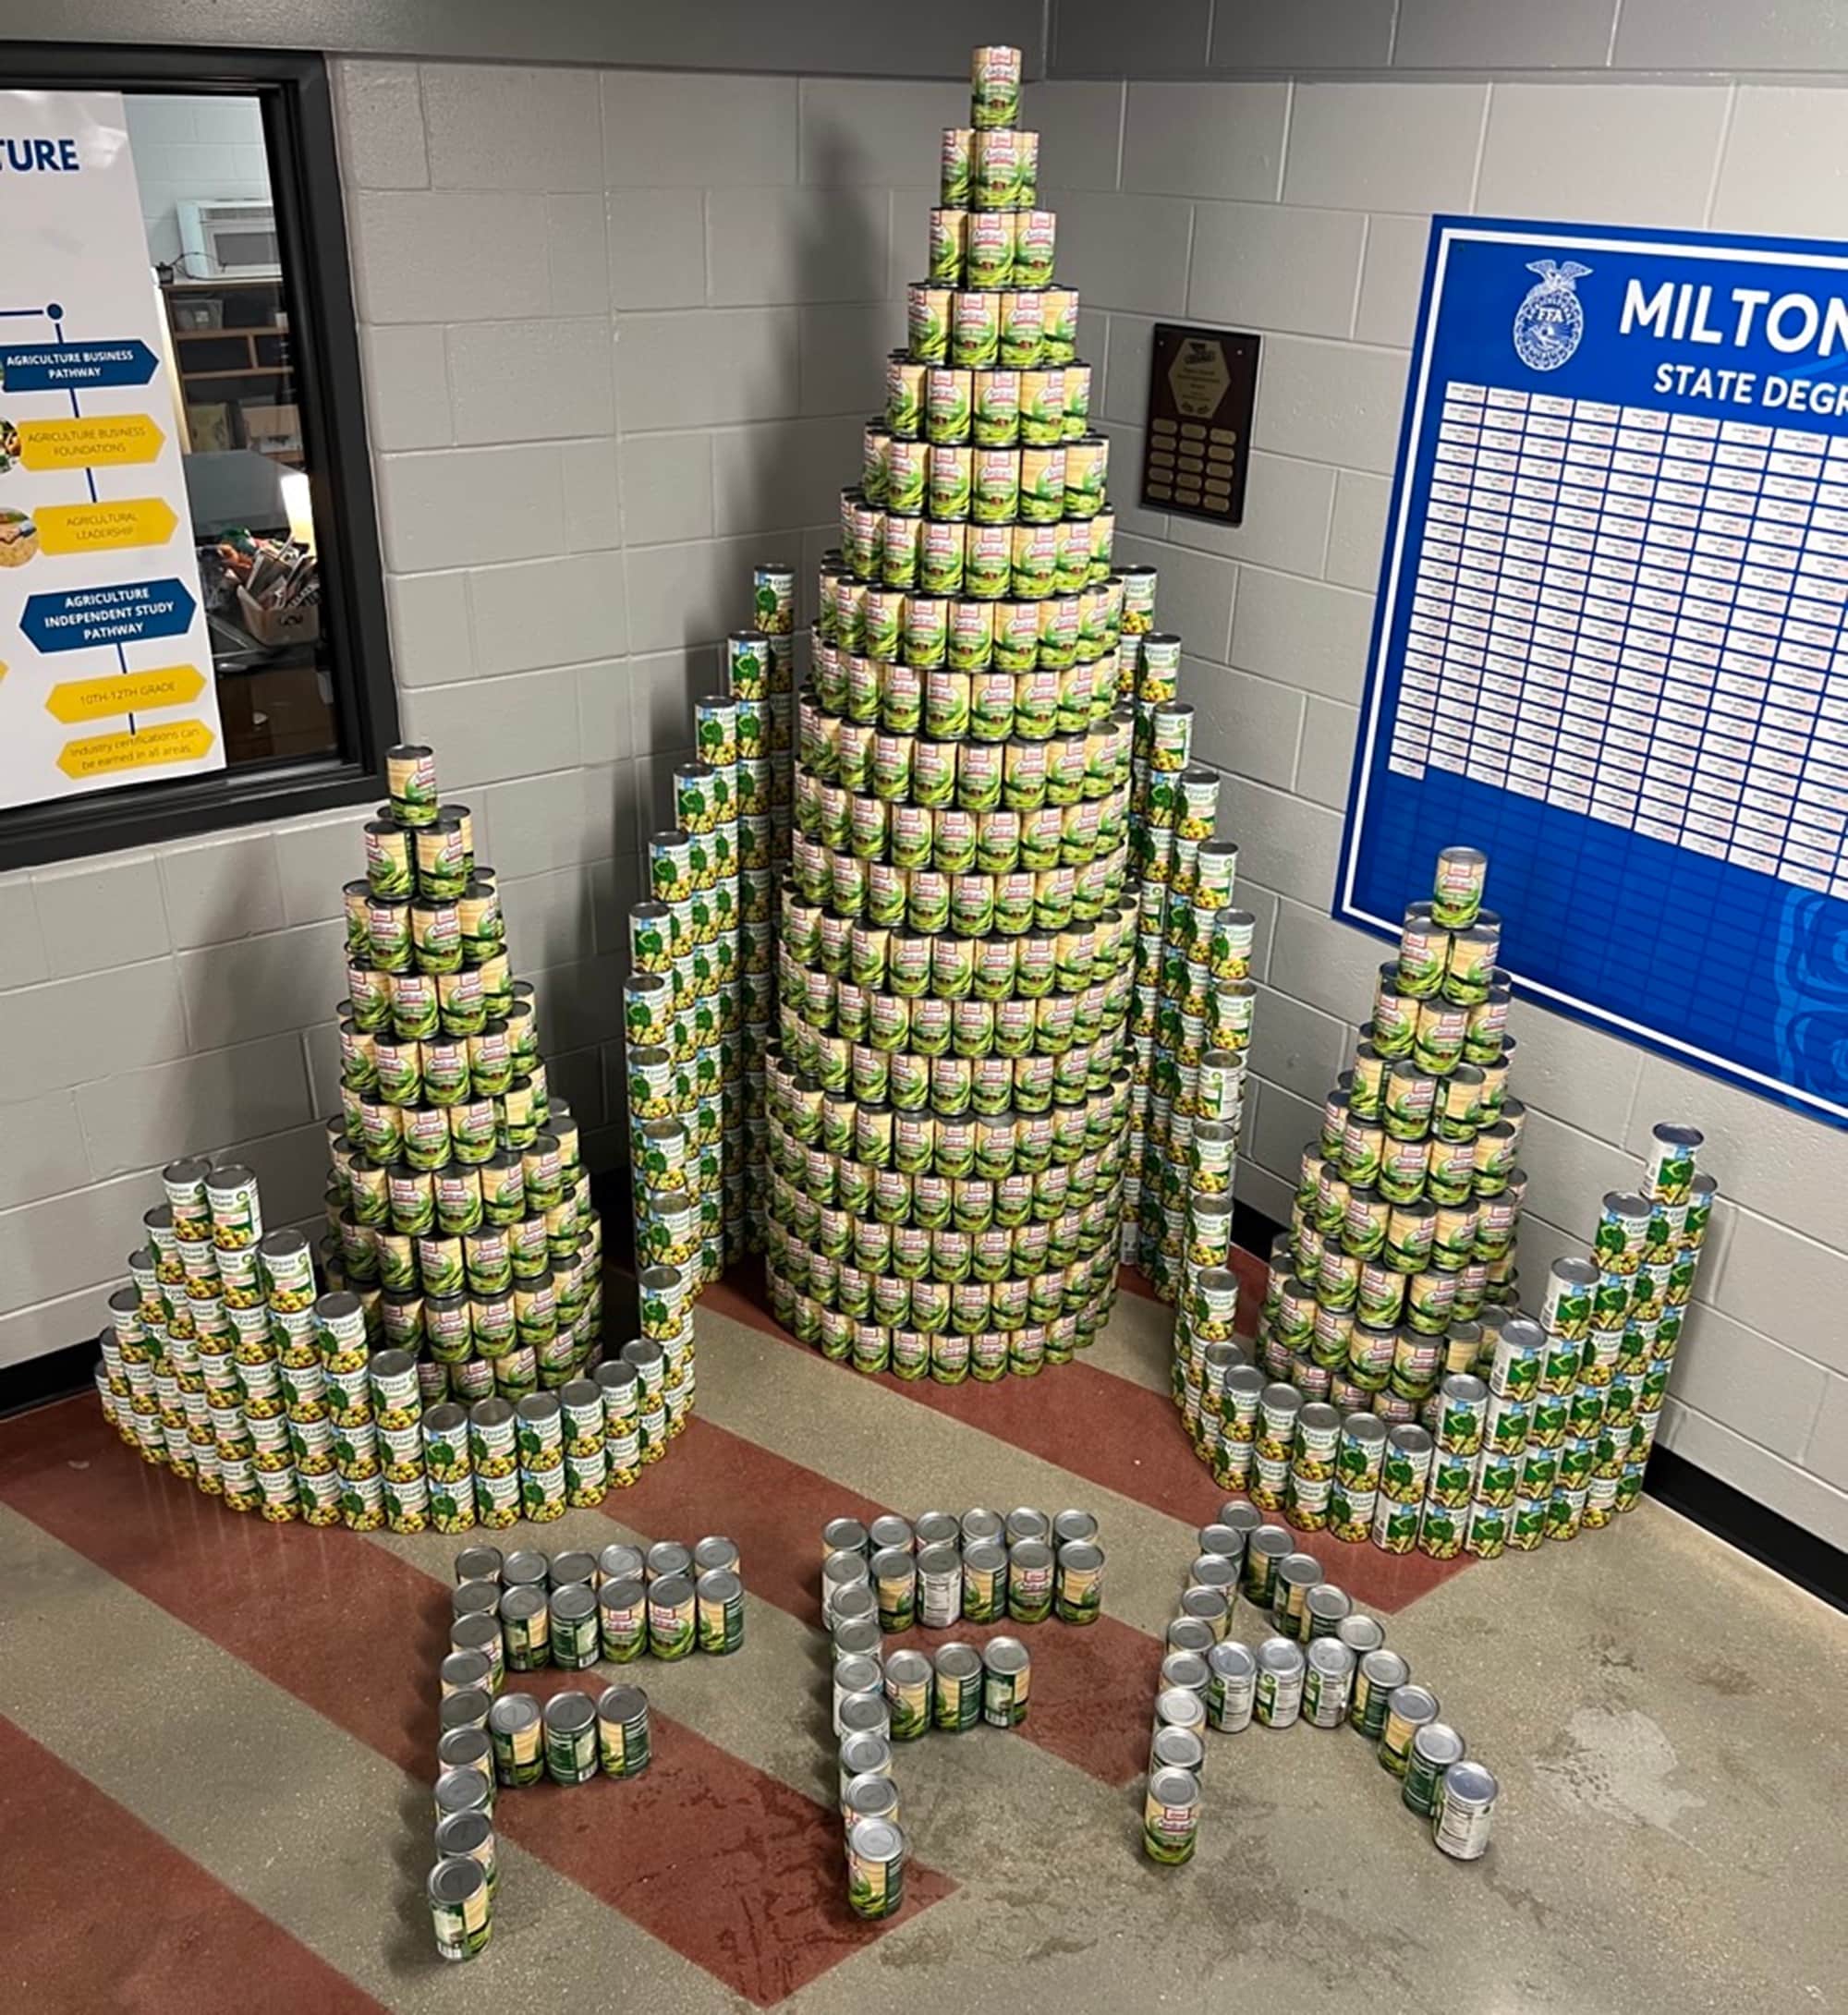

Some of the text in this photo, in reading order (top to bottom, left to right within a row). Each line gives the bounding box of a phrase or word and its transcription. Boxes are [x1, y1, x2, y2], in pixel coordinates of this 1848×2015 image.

[0, 139, 79, 172] URE
[1538, 307, 1566, 323] FFA
[6, 350, 134, 367] AGRICULTURE BUSINESS
[48, 367, 101, 380] PATHWAY
[1653, 362, 1757, 405] STATE
[28, 426, 147, 443] AGRICULTURE BUSINESS
[53, 443, 127, 457] FOUNDATIONS
[65, 588, 150, 609] AGRICULTURE
[44, 601, 175, 628] INDEPENDENT STUDY
[83, 622, 144, 640] PATHWAY
[140, 681, 176, 697] GRADE
[181, 727, 201, 740] can
[81, 759, 95, 771] be
[97, 752, 134, 767] earned
